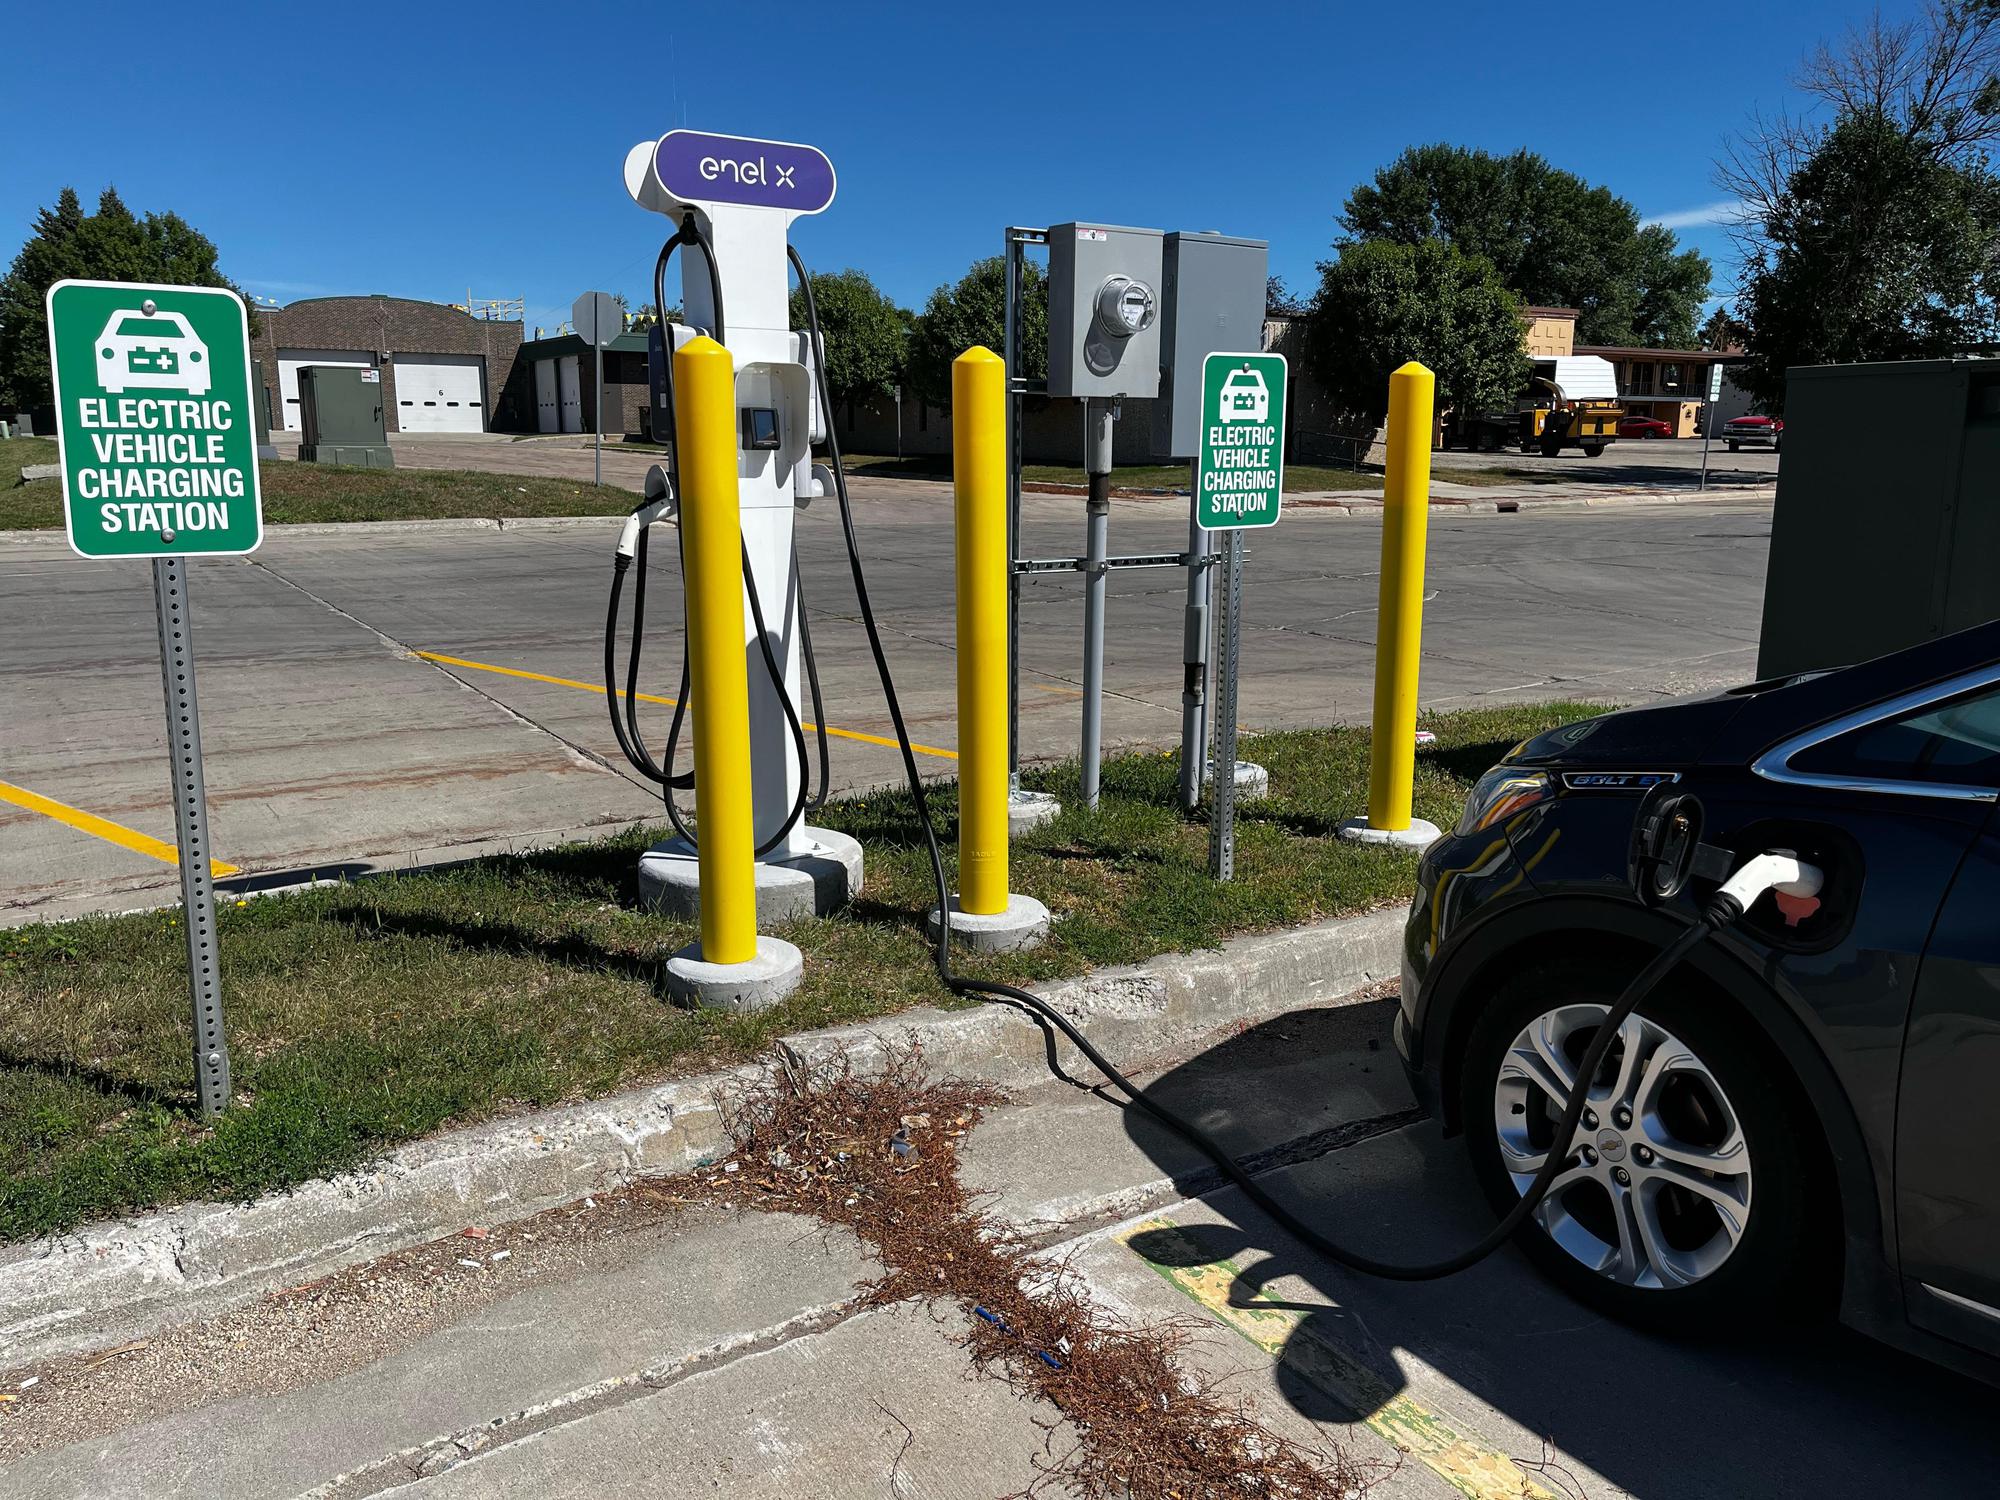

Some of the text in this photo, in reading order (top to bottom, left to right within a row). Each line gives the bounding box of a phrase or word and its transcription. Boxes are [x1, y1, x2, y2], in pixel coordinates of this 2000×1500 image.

[699, 156, 768, 186] enel
[438, 389, 444, 397] 6
[78, 398, 233, 430] ELECTRIC
[1209, 426, 1275, 446] ELECTRIC
[90, 433, 226, 464] VEHICLE
[1213, 449, 1270, 468] VEHICLE
[77, 467, 245, 499] CHARGING
[1204, 470, 1276, 491] CHARGING
[1211, 492, 1267, 514] STATION
[100, 501, 230, 533] STATION
[1573, 775, 1634, 785] BOLT
